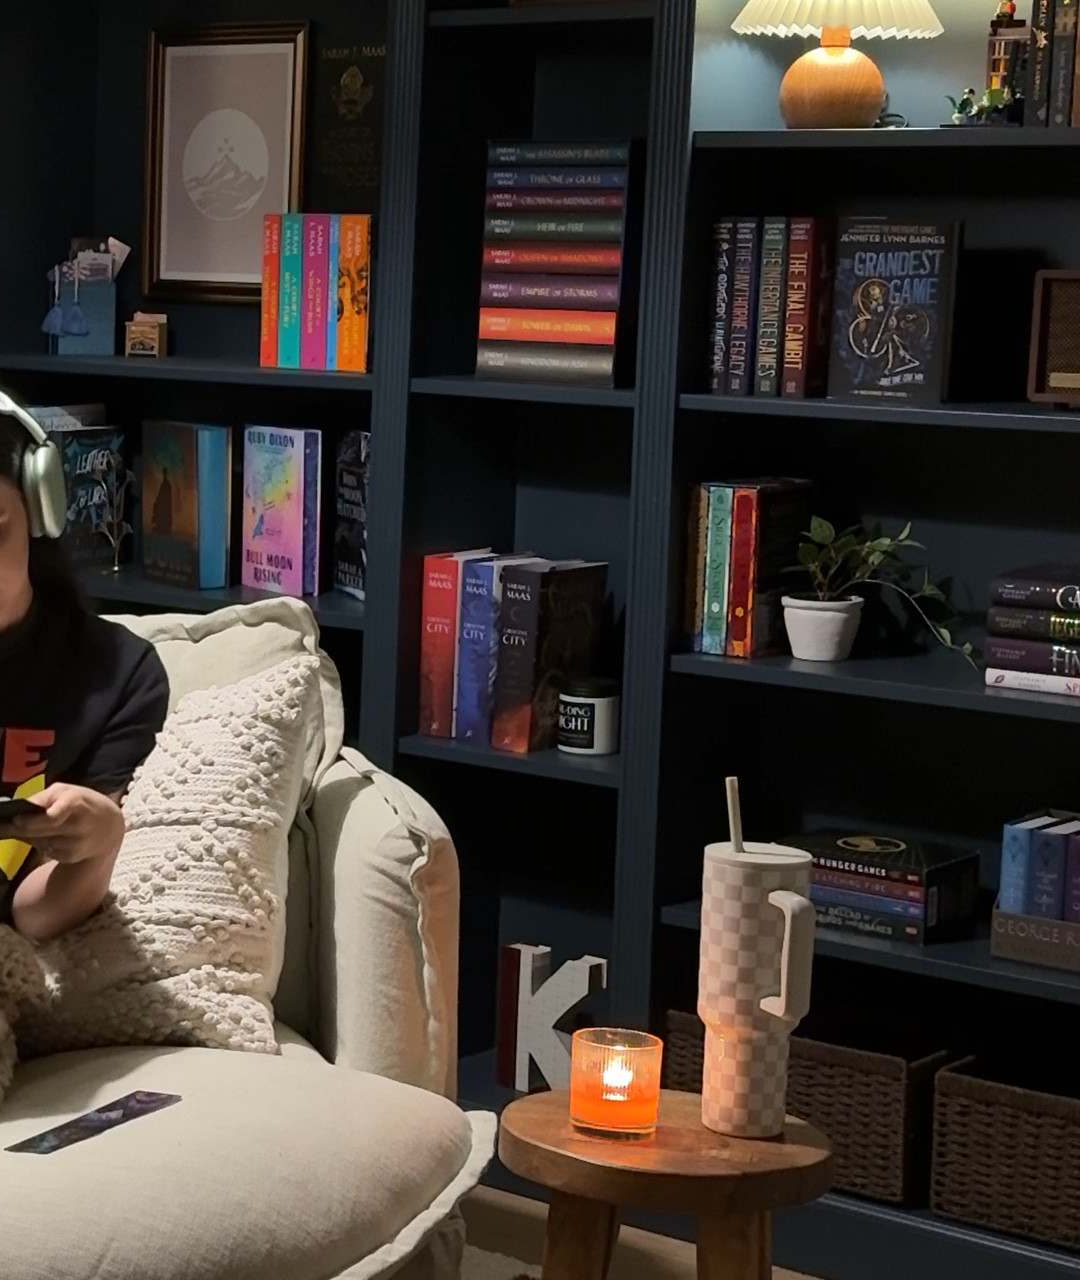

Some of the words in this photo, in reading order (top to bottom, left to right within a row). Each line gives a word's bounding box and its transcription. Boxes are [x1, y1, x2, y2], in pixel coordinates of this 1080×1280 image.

[320, 47, 349, 58] SARAH
[359, 44, 387, 57] MAAS
[529, 174, 563, 185] THRONE
[575, 174, 602, 185] GLASS
[520, 196, 552, 206] CROWN
[563, 196, 606, 206] MIDNIGHT
[536, 222, 556, 232] HEIR
[567, 222, 585, 233] FIRE
[308, 231, 316, 257] MAAS
[840, 234, 881, 244] JENNIFER
[882, 234, 907, 243] LYNN
[908, 235, 946, 245] BARNES
[734, 242, 753, 262] THE
[765, 245, 783, 265] THE
[791, 251, 808, 277] THE
[854, 249, 945, 277] GRANDEST
[283, 271, 291, 294] MIST
[520, 286, 550, 297] EMPIRE
[563, 288, 599, 299] STORMS
[889, 278, 938, 305] GAME
[731, 266, 751, 330] HAWTHORNE
[759, 266, 781, 336] INHERITANCE
[785, 281, 807, 319] FINAL
[283, 305, 291, 329] FURY
[728, 334, 746, 376] LEGACY
[783, 323, 804, 371] GAMBIT
[756, 338, 778, 378] GAMES
[247, 431, 267, 446] RUBY
[269, 432, 295, 449] DIXON
[76, 447, 113, 475] LEATHER
[246, 549, 264, 566] BULL
[266, 552, 293, 571] MOON
[253, 566, 283, 586] RISING
[428, 579, 453, 590] MAAS
[465, 584, 489, 596] MAAS
[506, 591, 532, 602] MAAS
[426, 623, 450, 634] CITY
[463, 629, 486, 641] CITY
[502, 634, 528, 647] CITY
[819, 857, 857, 873] HUNGER
[857, 864, 887, 877] GAMES
[828, 906, 862, 920] BALLAD
[993, 918, 1060, 945] GEORGE
